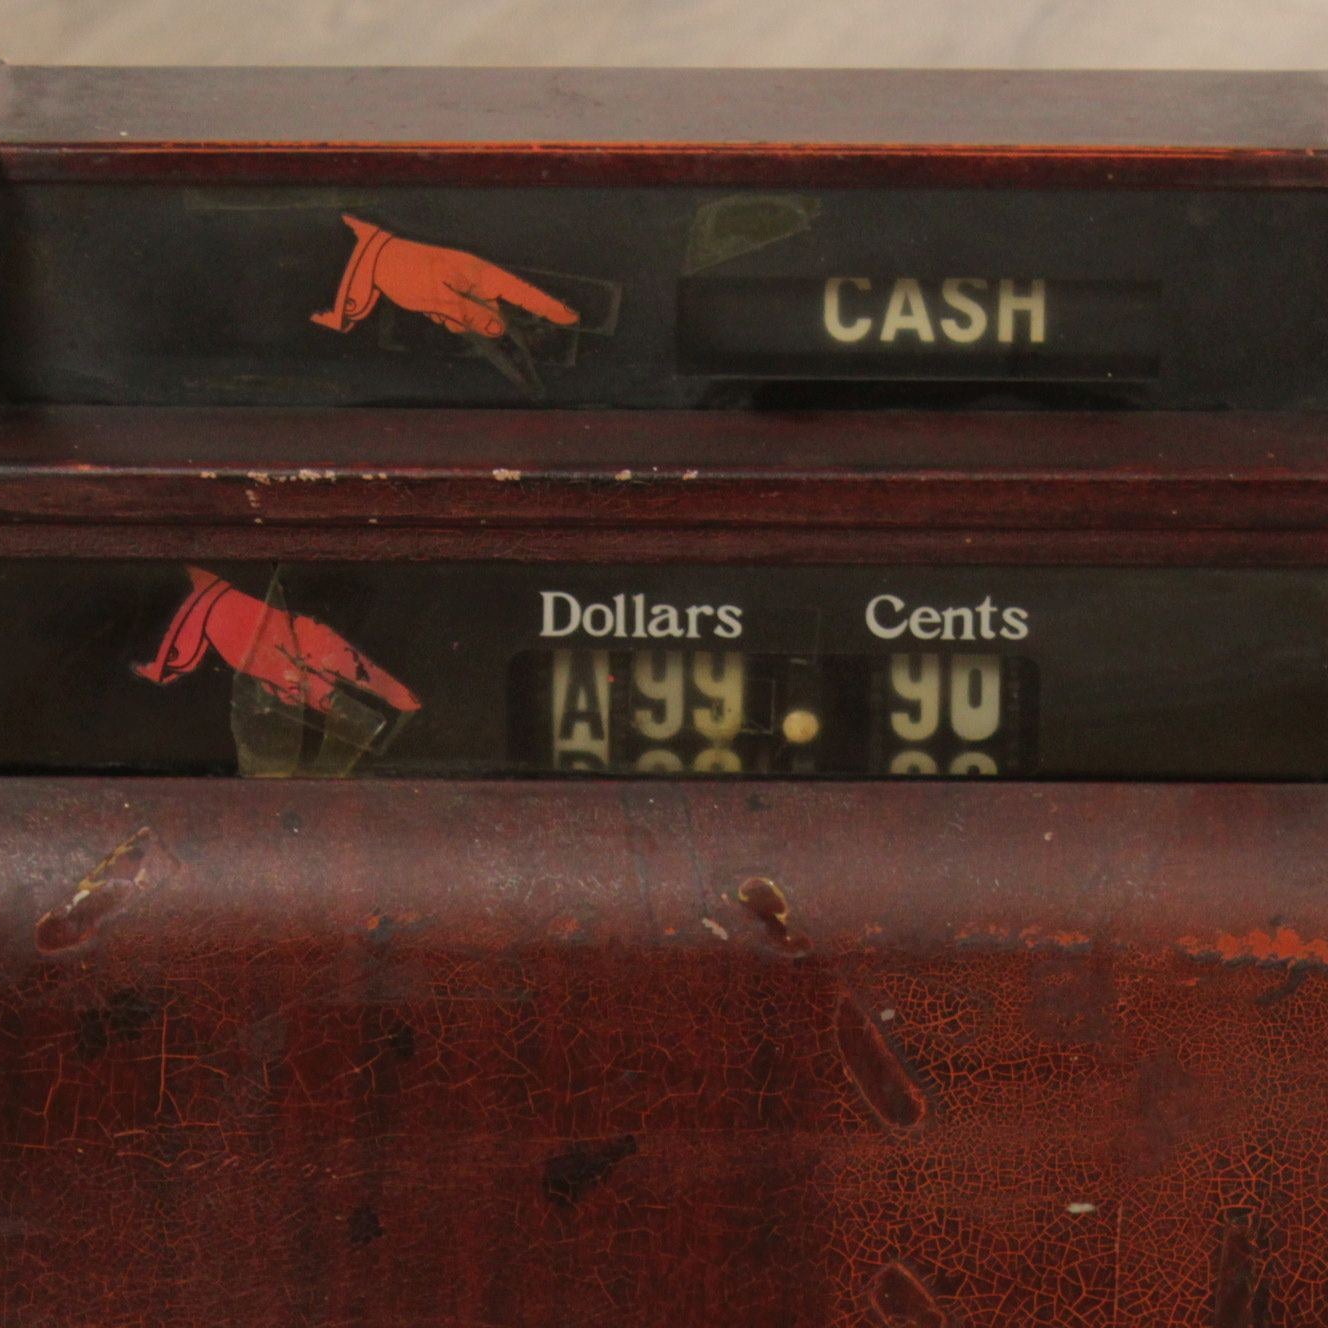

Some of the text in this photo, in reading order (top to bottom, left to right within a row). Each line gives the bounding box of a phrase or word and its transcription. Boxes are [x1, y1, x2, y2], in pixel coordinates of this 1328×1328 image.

[823, 278, 1046, 343] CASH
[539, 591, 1029, 640] Dollars Cents
